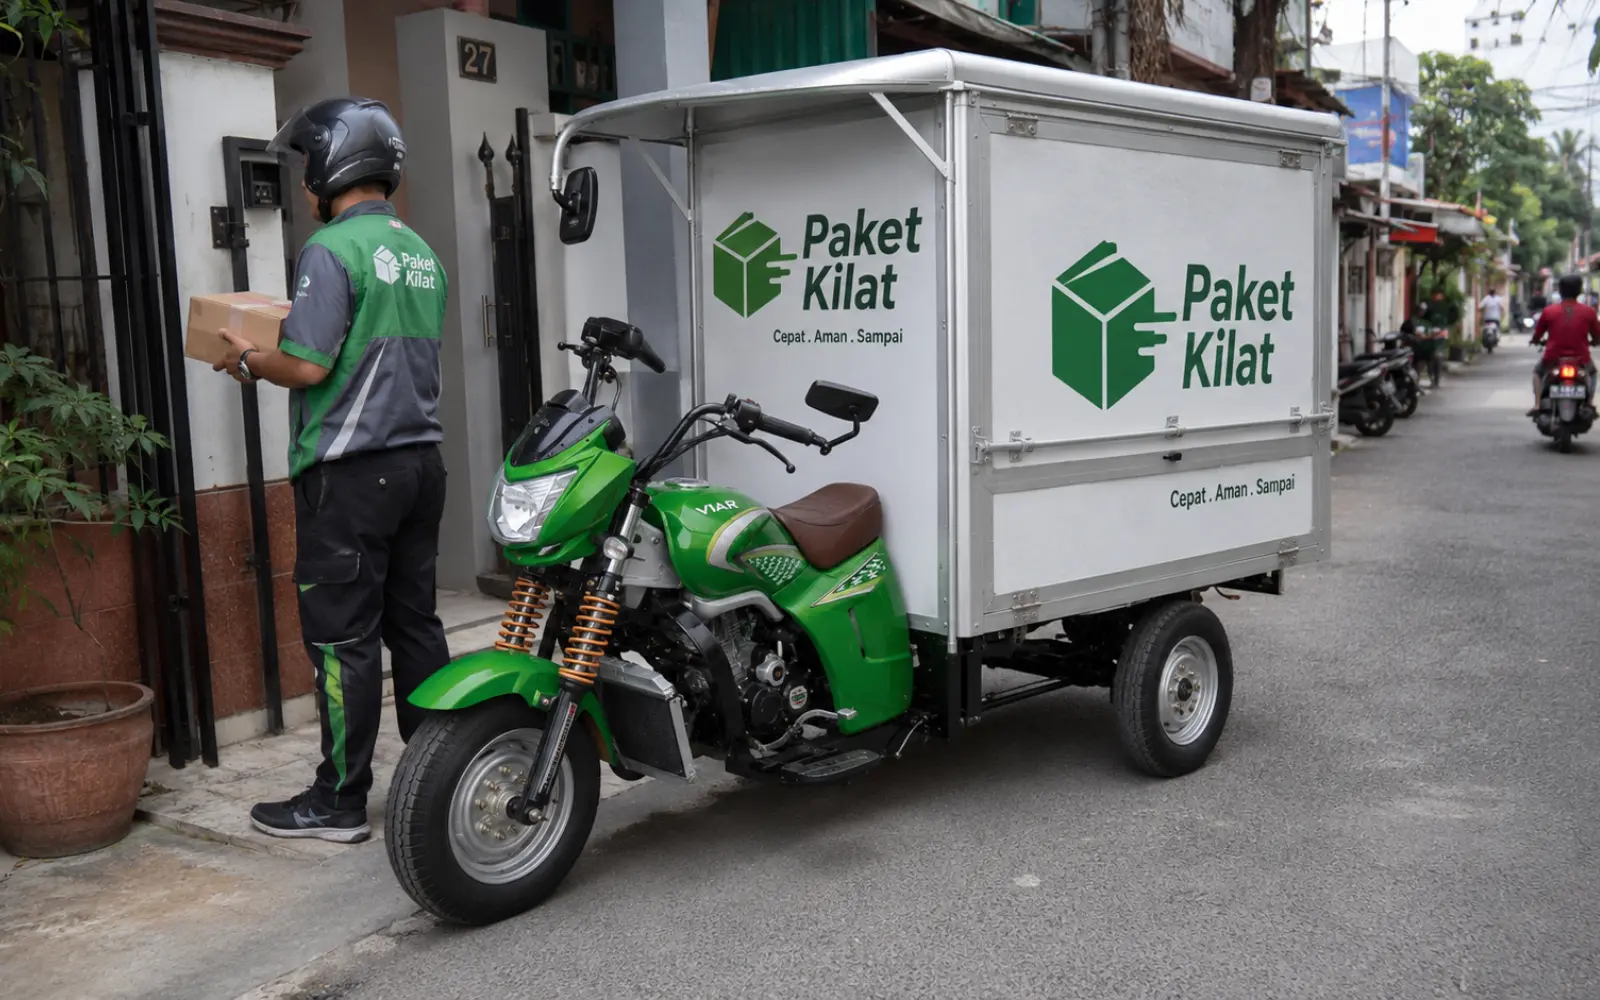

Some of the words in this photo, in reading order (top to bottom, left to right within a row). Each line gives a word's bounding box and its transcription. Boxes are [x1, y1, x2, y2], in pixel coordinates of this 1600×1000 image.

[464, 42, 492, 75] 27
[802, 207, 923, 259] Paket
[401, 252, 436, 272] Paket
[405, 270, 435, 289] Kilat
[802, 262, 898, 310] Kilat
[1182, 264, 1295, 322] Paket
[773, 329, 805, 346] Cepat
[814, 330, 848, 343] Aman
[857, 328, 903, 347] Sampai
[1182, 327, 1275, 389] Kilat
[695, 500, 739, 515] VIAR
[1170, 487, 1206, 510] Cepat
[1215, 483, 1248, 501] Aman
[1256, 473, 1295, 496] Sampai
